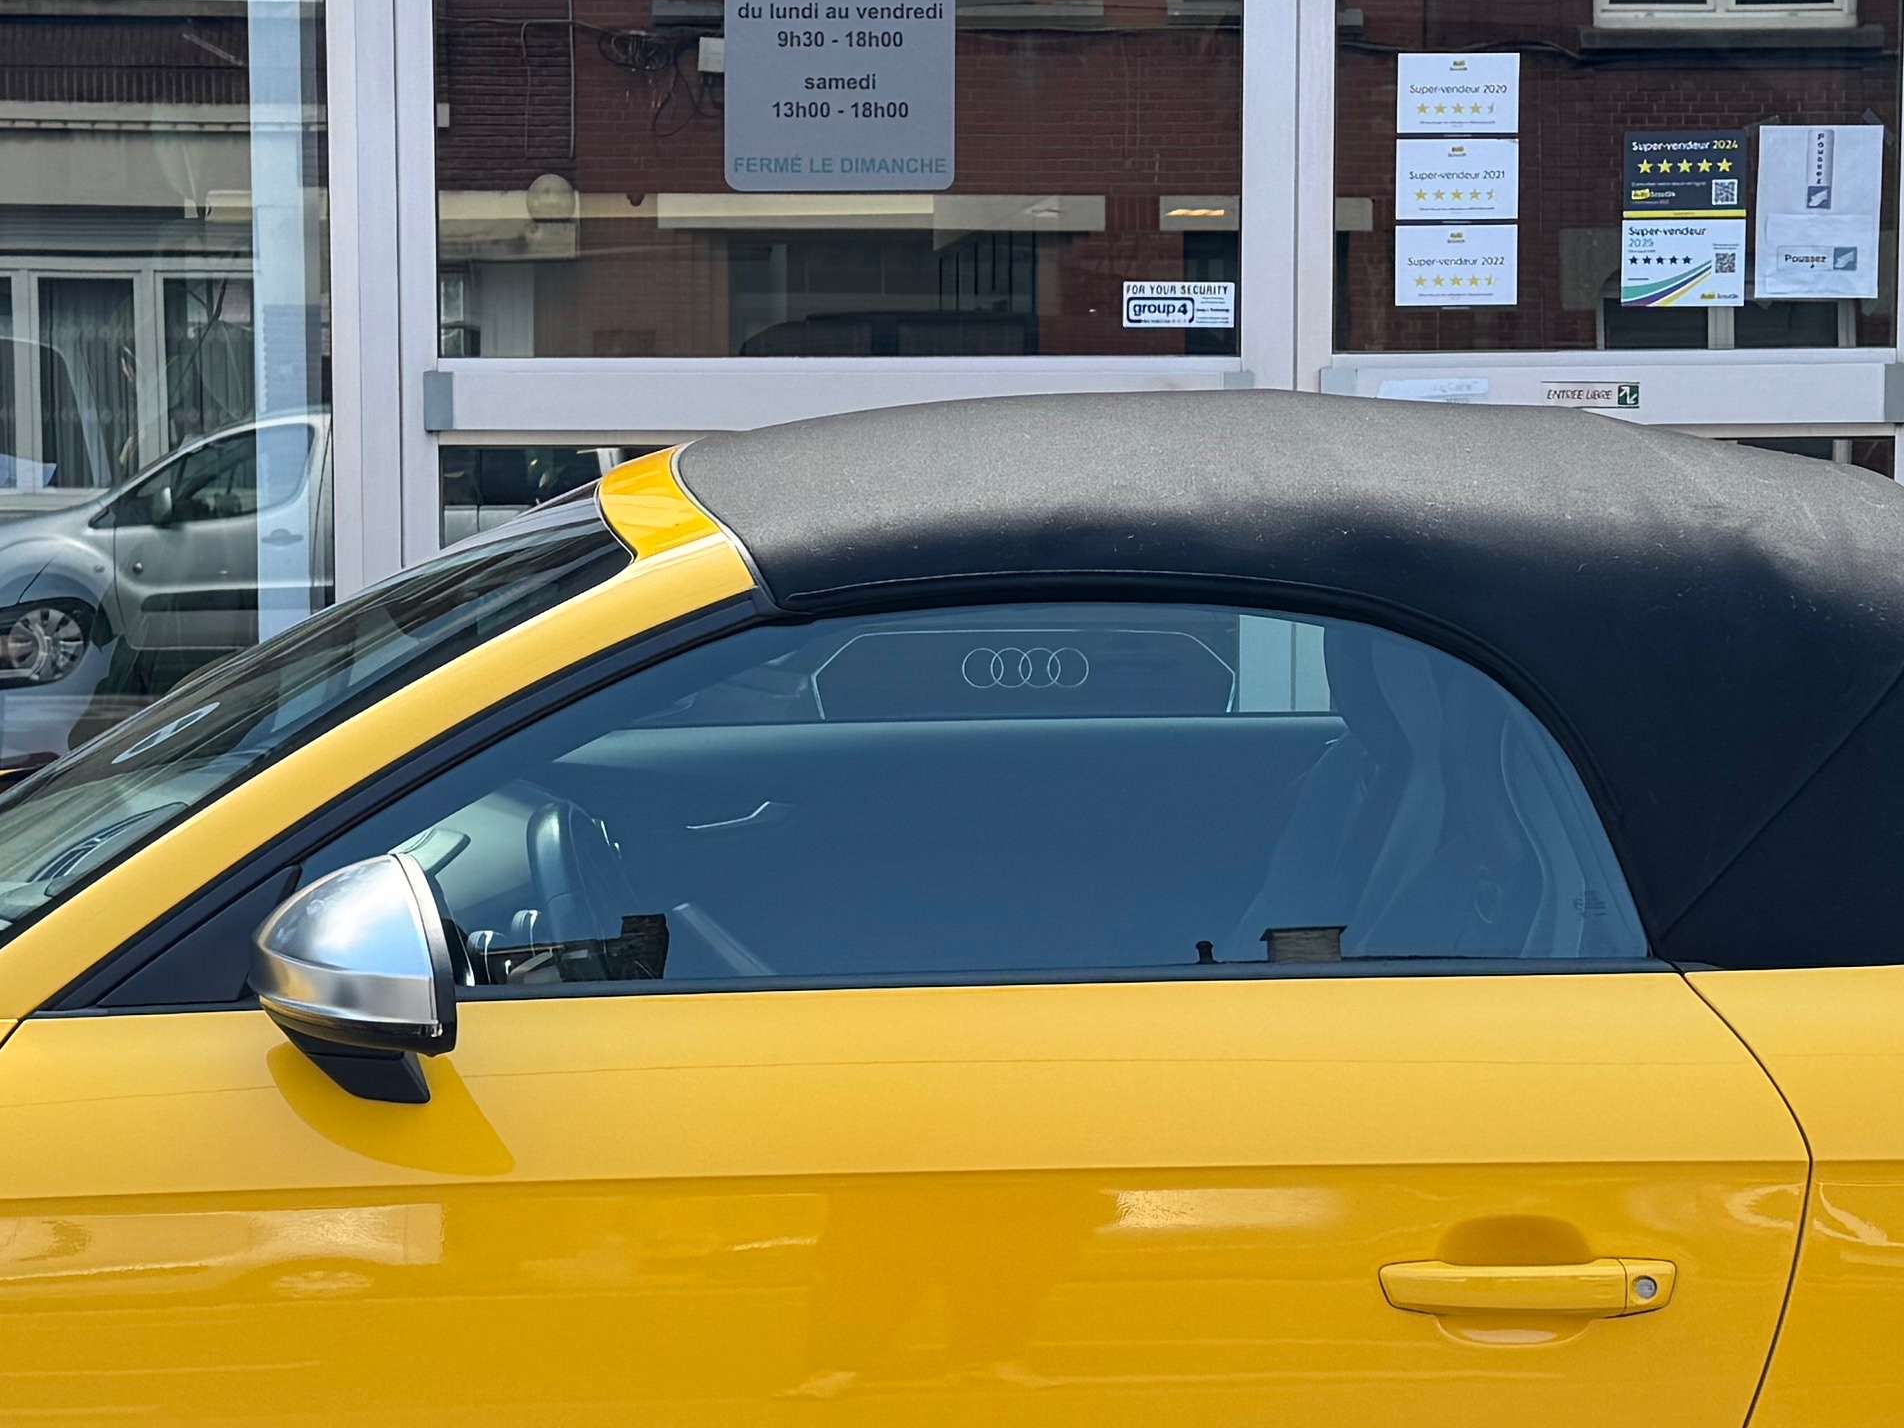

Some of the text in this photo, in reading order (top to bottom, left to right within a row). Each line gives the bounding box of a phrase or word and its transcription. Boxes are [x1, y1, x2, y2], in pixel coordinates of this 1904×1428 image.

[737, 2, 944, 19] du lundi au vendredi
[777, 30, 825, 47] 9h30
[845, 30, 903, 47] 18h00
[804, 73, 876, 90] samedi
[1409, 84, 1508, 95] Super-vendeur 2020
[772, 101, 831, 118] 13h00
[850, 101, 909, 118] 18h00
[1631, 139, 1739, 152] Super-vendeur 2024
[809, 156, 834, 173] LE
[840, 156, 947, 174] DIMANCHE
[1409, 170, 1505, 181] Super-vendeur 2021
[1628, 226, 1707, 237] Super-vendeur
[1407, 256, 1505, 267] Super-vendeur 2022
[1784, 254, 1827, 264] Poussez
[1126, 284, 1228, 295] FOR YOUR SECURITY
